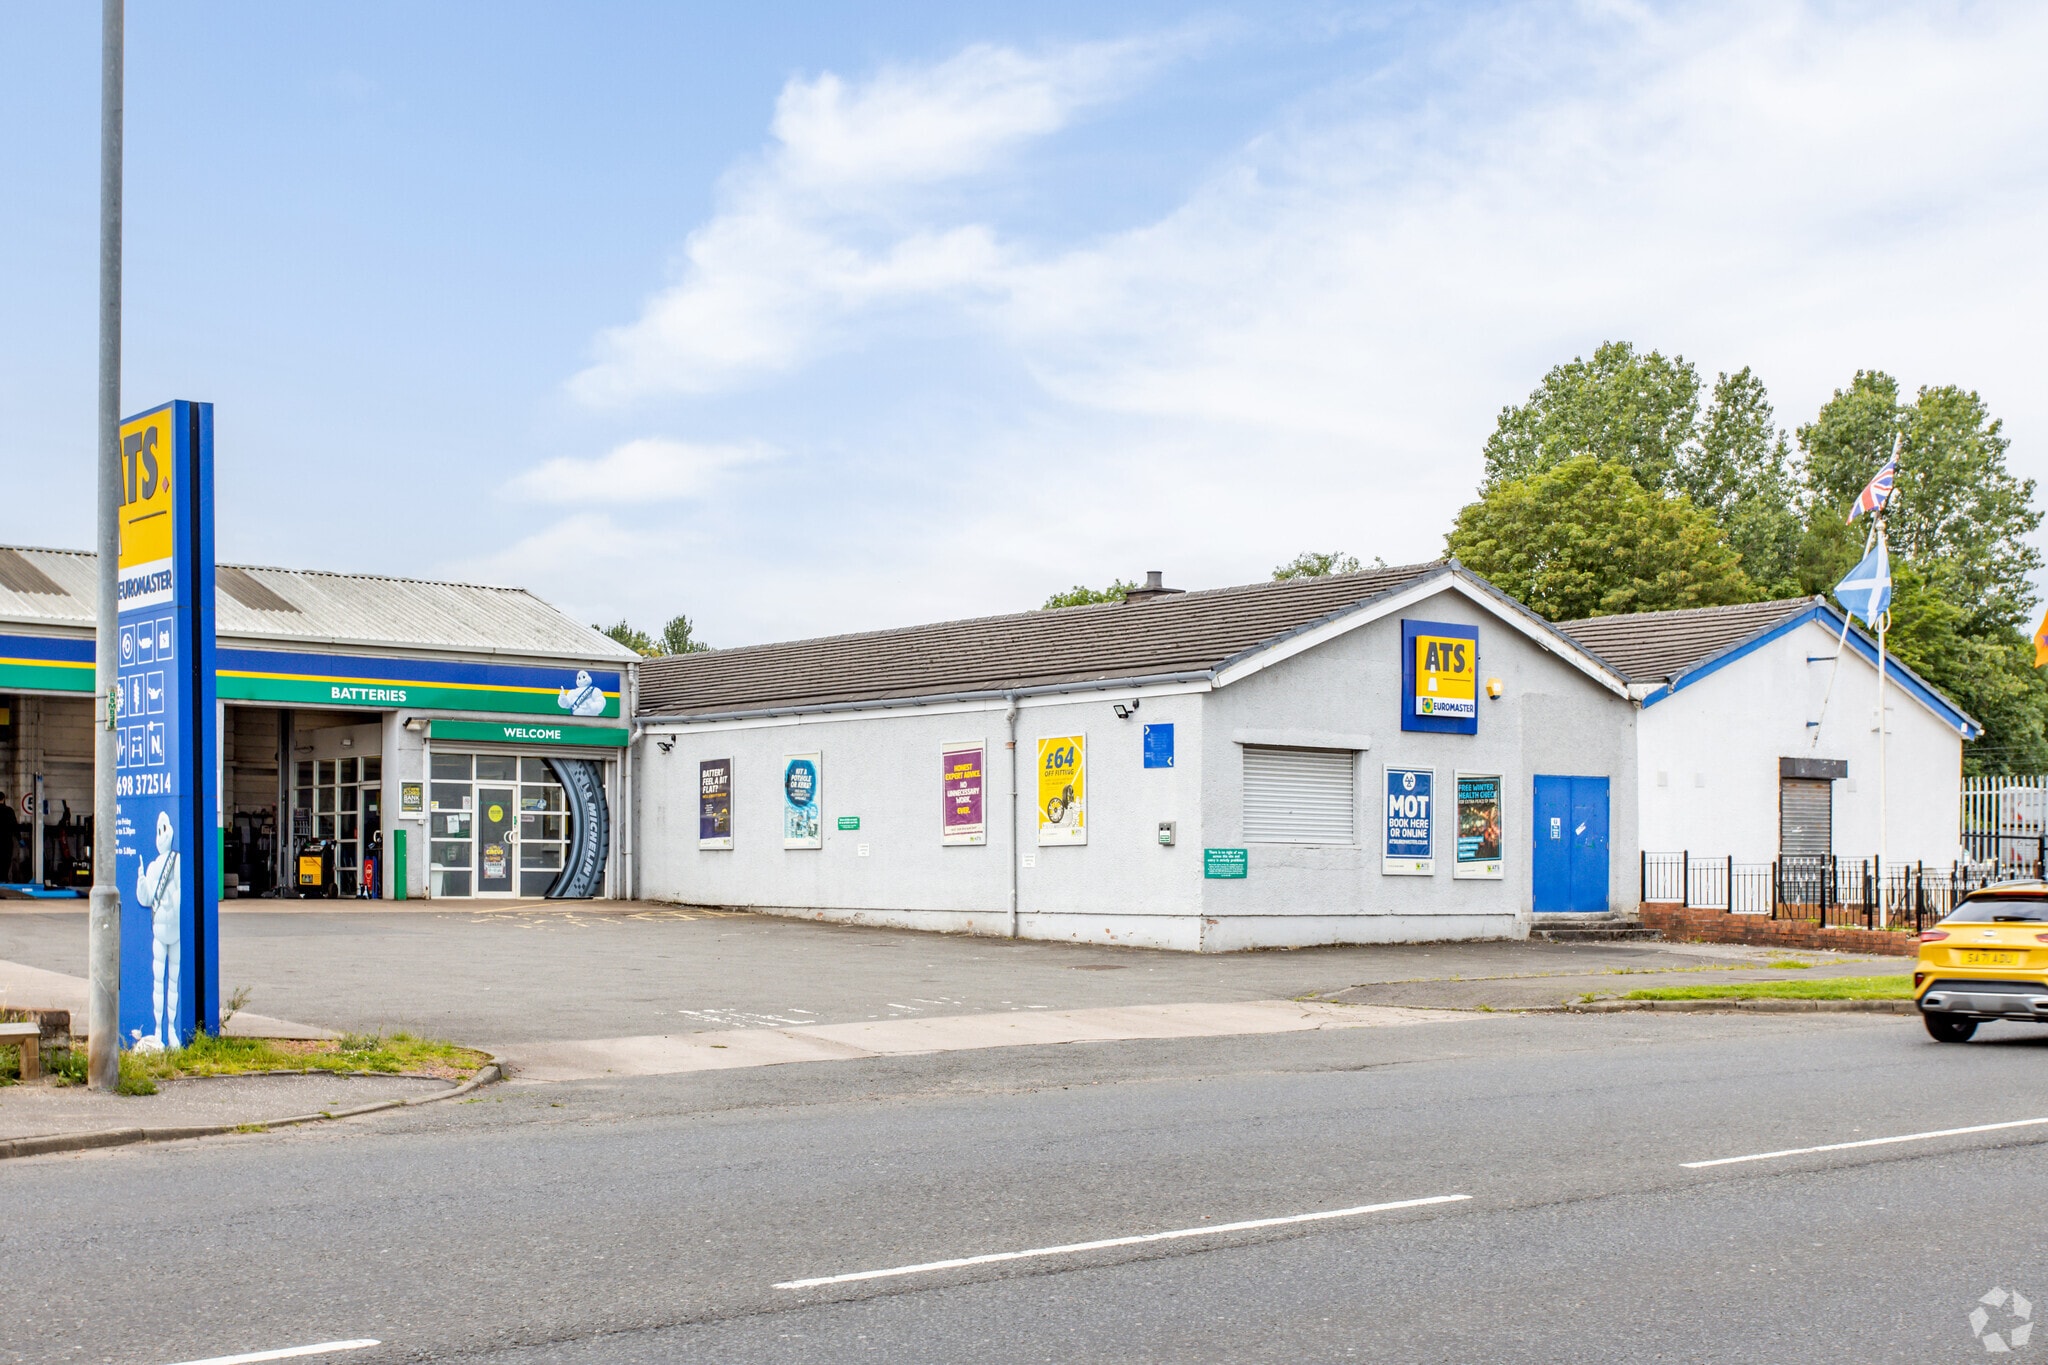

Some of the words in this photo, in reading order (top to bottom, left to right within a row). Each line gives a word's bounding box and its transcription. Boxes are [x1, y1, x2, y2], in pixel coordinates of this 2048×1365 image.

[1424, 641, 1466, 674] ATS
[331, 686, 407, 702] BATTERIES
[1433, 702, 1474, 713] EUROMASTER
[503, 727, 561, 740] WELCOME
[1045, 746, 1075, 770] £64
[702, 768, 725, 778] BATTERY
[135, 772, 171, 796] 372514
[702, 778, 714, 786] FEEL
[702, 785, 719, 794] FLAT?
[1458, 791, 1480, 800] HEALTH
[1389, 794, 1430, 818] MOT
[1389, 818, 1409, 828] BOOK
[1410, 818, 1429, 829] HERE
[1390, 828, 1401, 837] OR
[1402, 828, 1428, 838] ONLINE
[583, 802, 598, 877] MICHELIN
